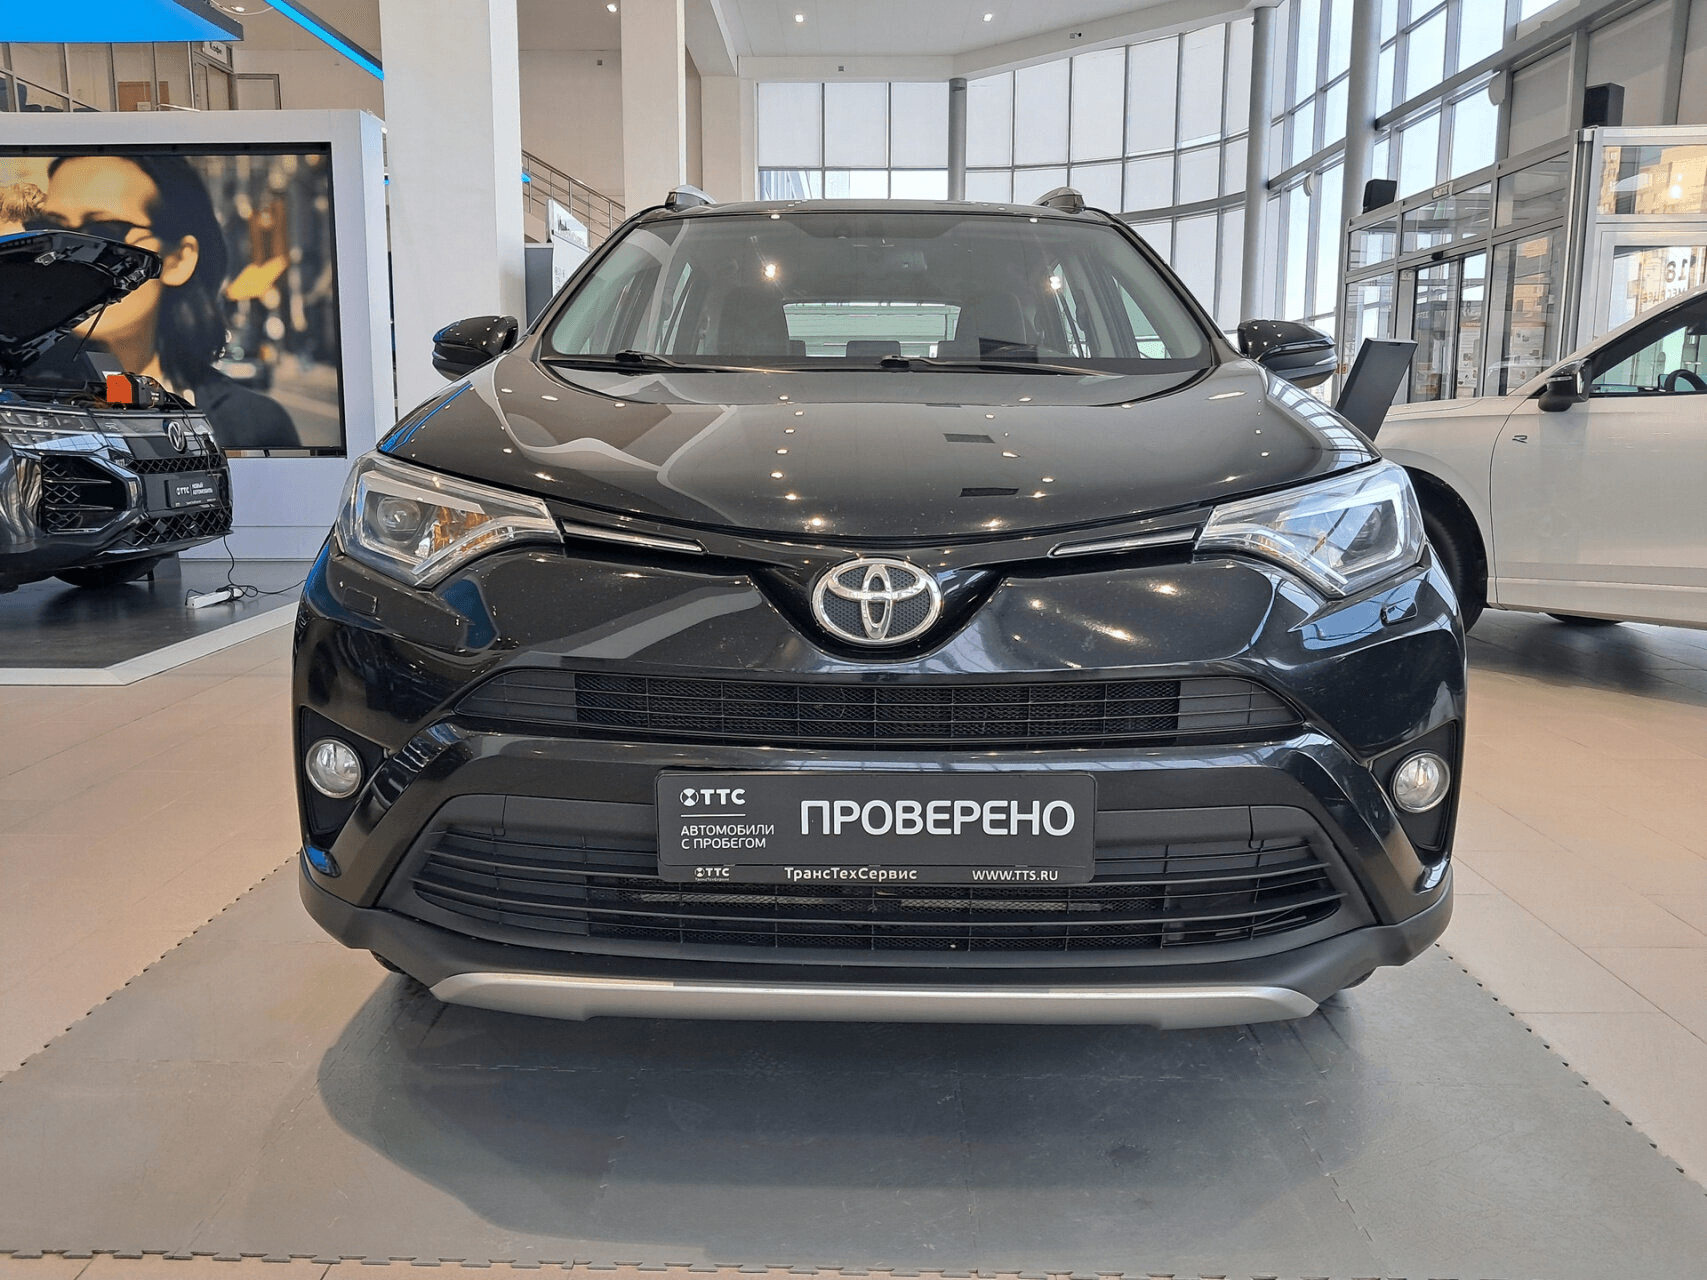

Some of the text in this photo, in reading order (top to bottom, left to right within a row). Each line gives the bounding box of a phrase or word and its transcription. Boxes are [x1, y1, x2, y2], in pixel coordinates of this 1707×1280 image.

[700, 788, 746, 805] ТТС
[800, 800, 1075, 836] ПРОВЕРЕНО
[680, 824, 775, 837] АВТОМОБИЛИ
[681, 837, 766, 849] С ПРОБЕГОМ
[705, 867, 730, 877] ТТС
[784, 867, 918, 882] ТрансТехСервис
[972, 870, 1059, 881] WWW.TTS.RU
